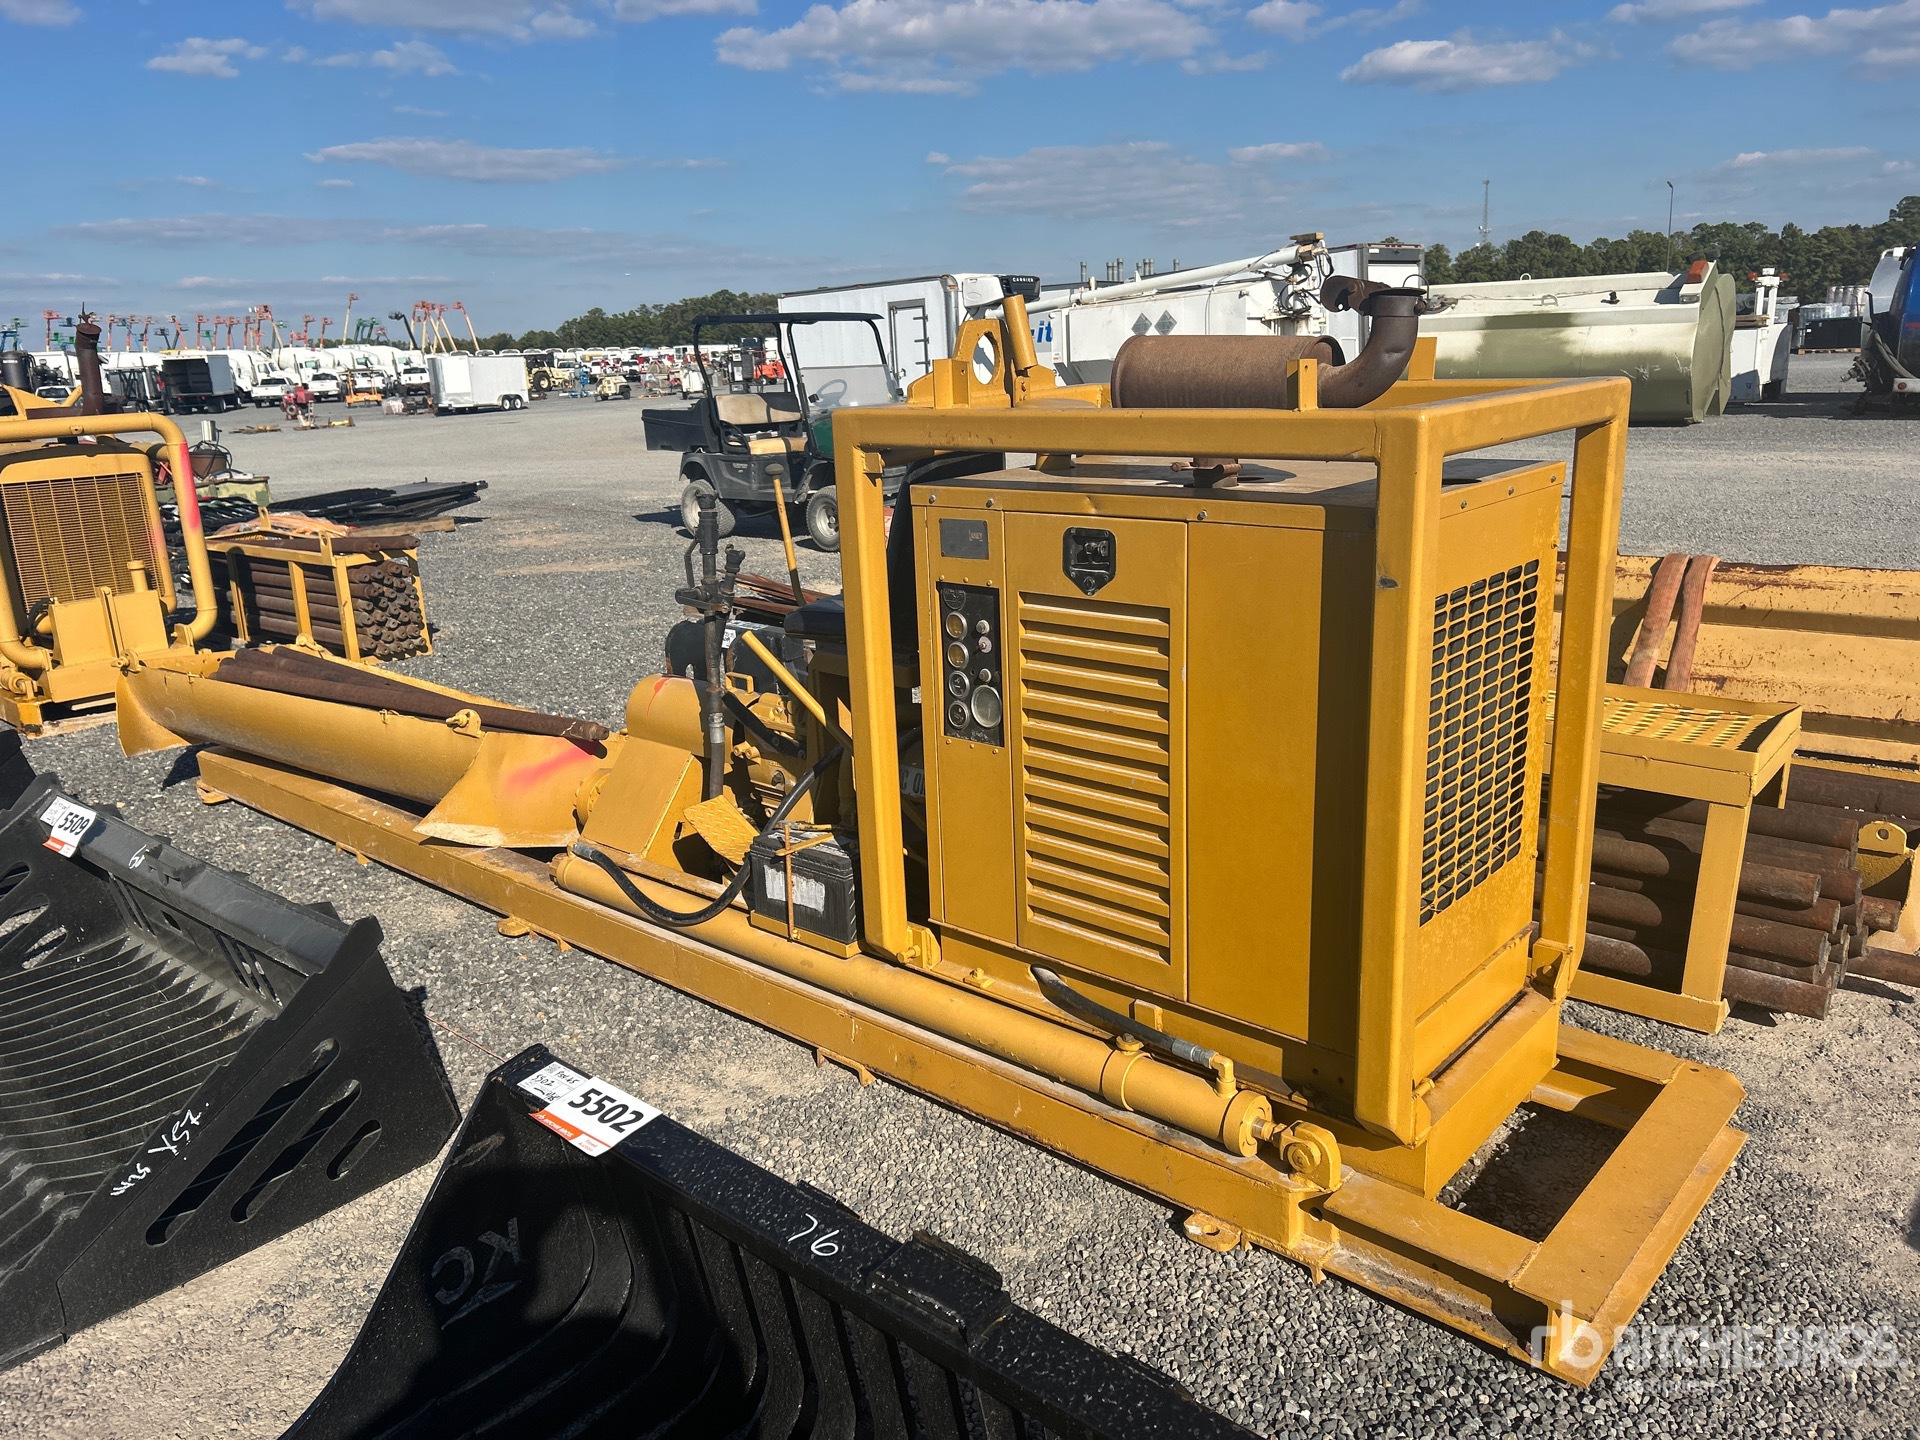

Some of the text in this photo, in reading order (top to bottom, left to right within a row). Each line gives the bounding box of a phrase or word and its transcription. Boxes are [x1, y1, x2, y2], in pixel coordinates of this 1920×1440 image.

[57, 811, 91, 836] 5509
[567, 1087, 645, 1134] 5502
[787, 1212, 840, 1257] 76
